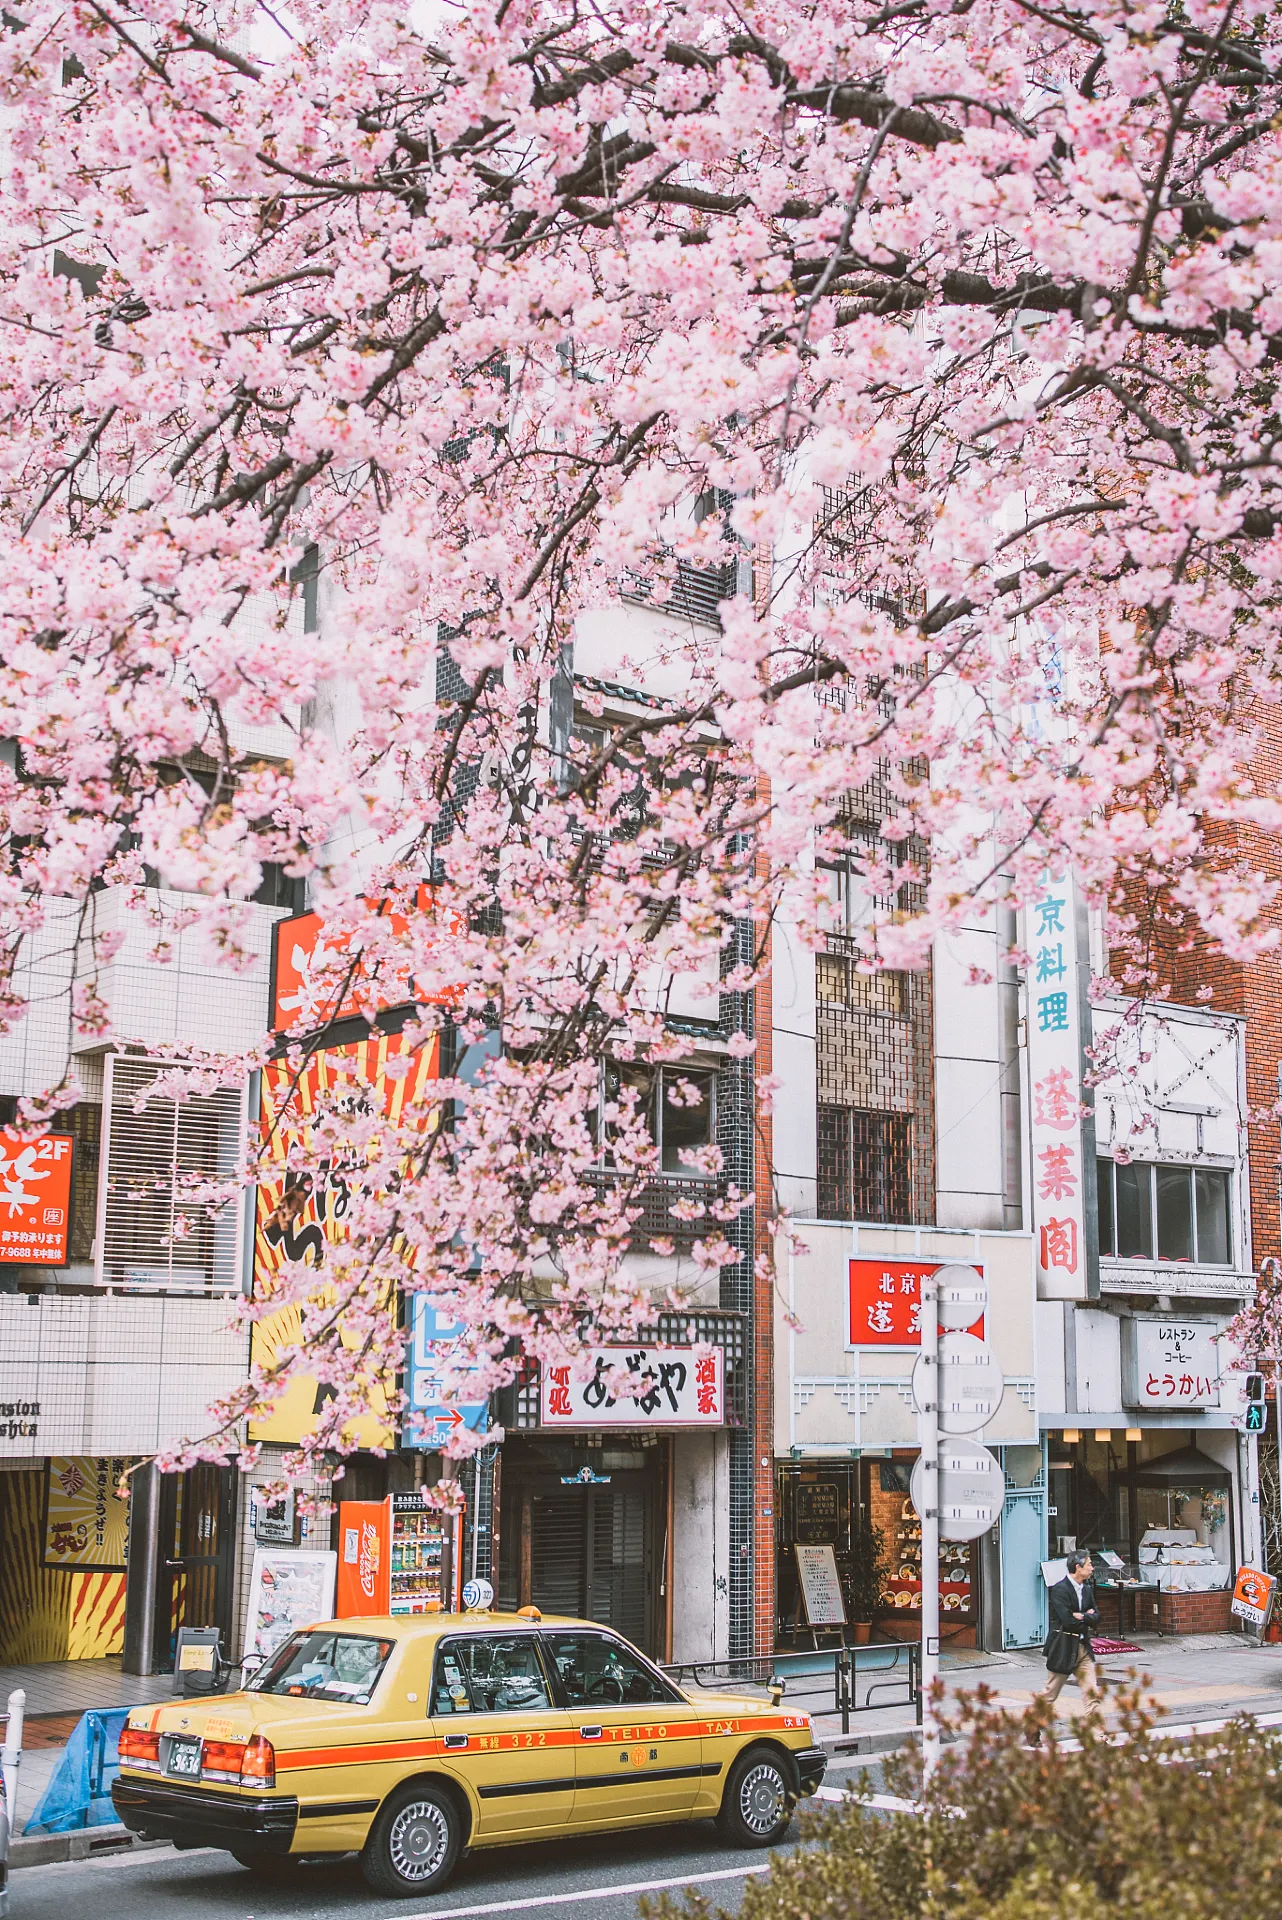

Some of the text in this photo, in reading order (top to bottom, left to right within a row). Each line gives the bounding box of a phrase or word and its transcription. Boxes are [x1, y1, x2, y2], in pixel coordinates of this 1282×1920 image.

[37, 1139, 69, 1160] 2F
[1034, 1065, 1079, 1275] 蓬莱閣
[44, 1209, 62, 1224] 座
[2, 1231, 63, 1244] 御予約承ります
[33, 1248, 62, 1259] 年中無休
[1159, 1327, 1196, 1341] レストラン
[1175, 1341, 1181, 1351] &
[1165, 1352, 1193, 1363] コーヒー
[1146, 1373, 1211, 1397] とうかい
[1233, 1606, 1260, 1621] とうかい
[608, 1720, 740, 1740] TEITO TAXI
[511, 1733, 546, 1747] 322
